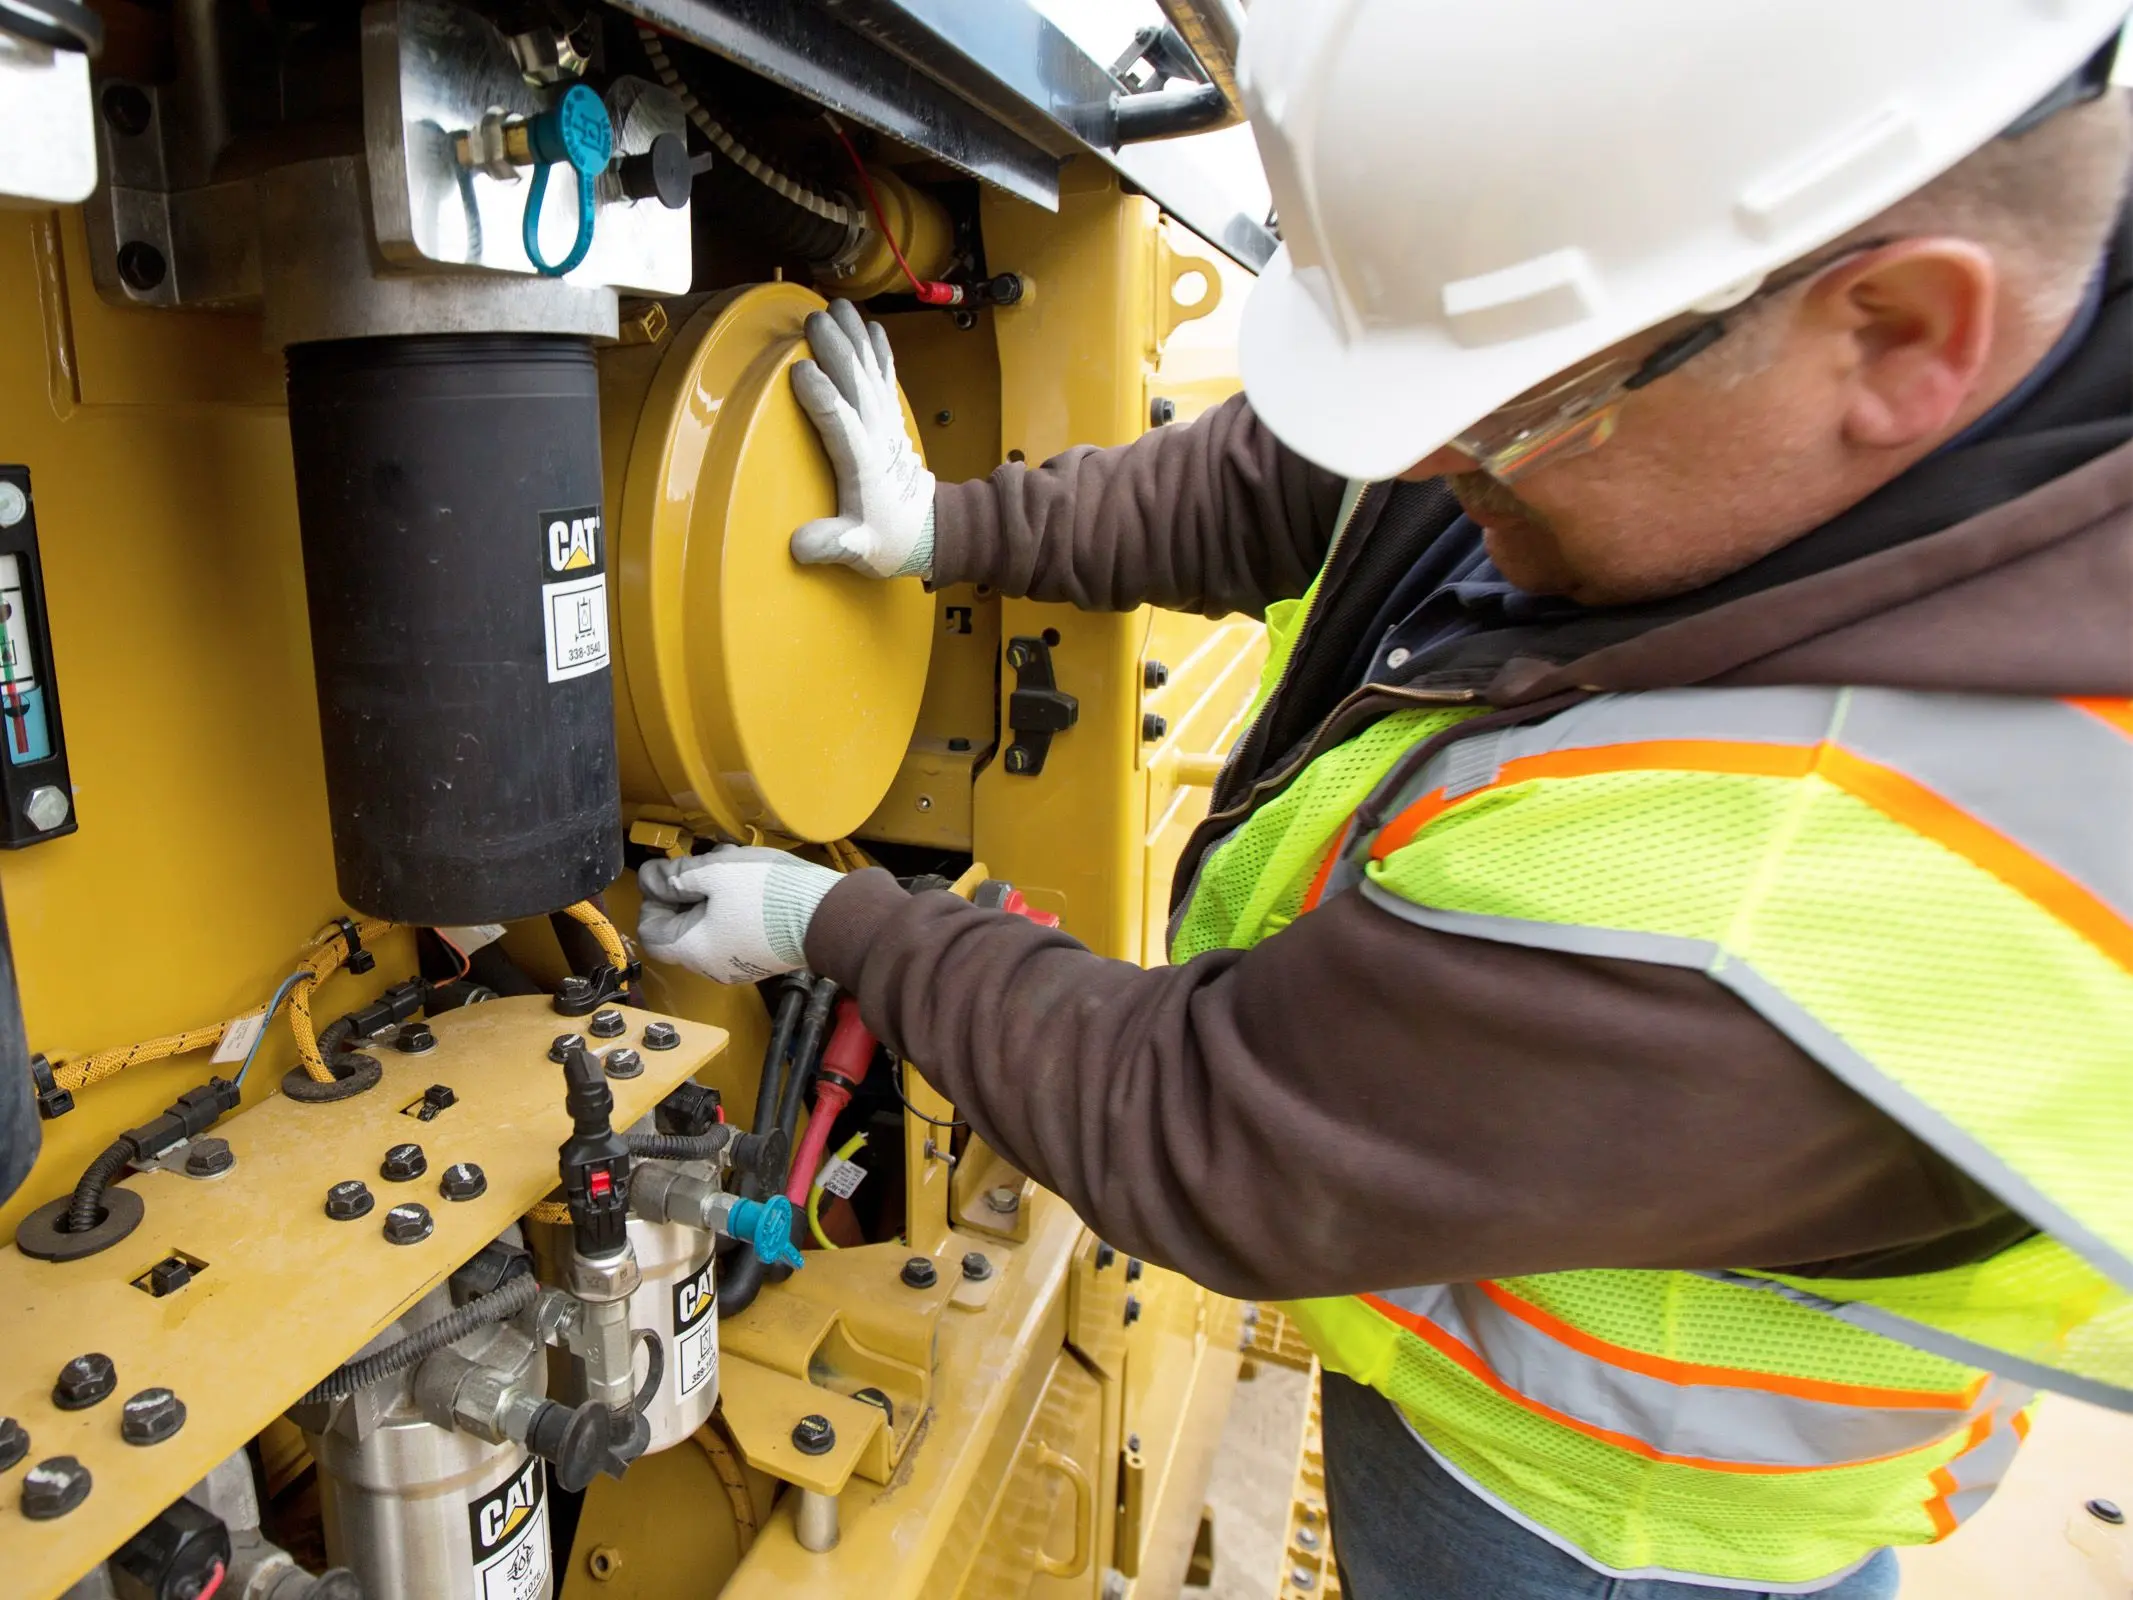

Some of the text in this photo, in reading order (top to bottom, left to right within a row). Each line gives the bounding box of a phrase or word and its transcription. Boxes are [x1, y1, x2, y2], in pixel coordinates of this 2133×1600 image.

[548, 516, 597, 572] CAT
[679, 1260, 715, 1323] CAT
[480, 1459, 535, 1547] CAT
